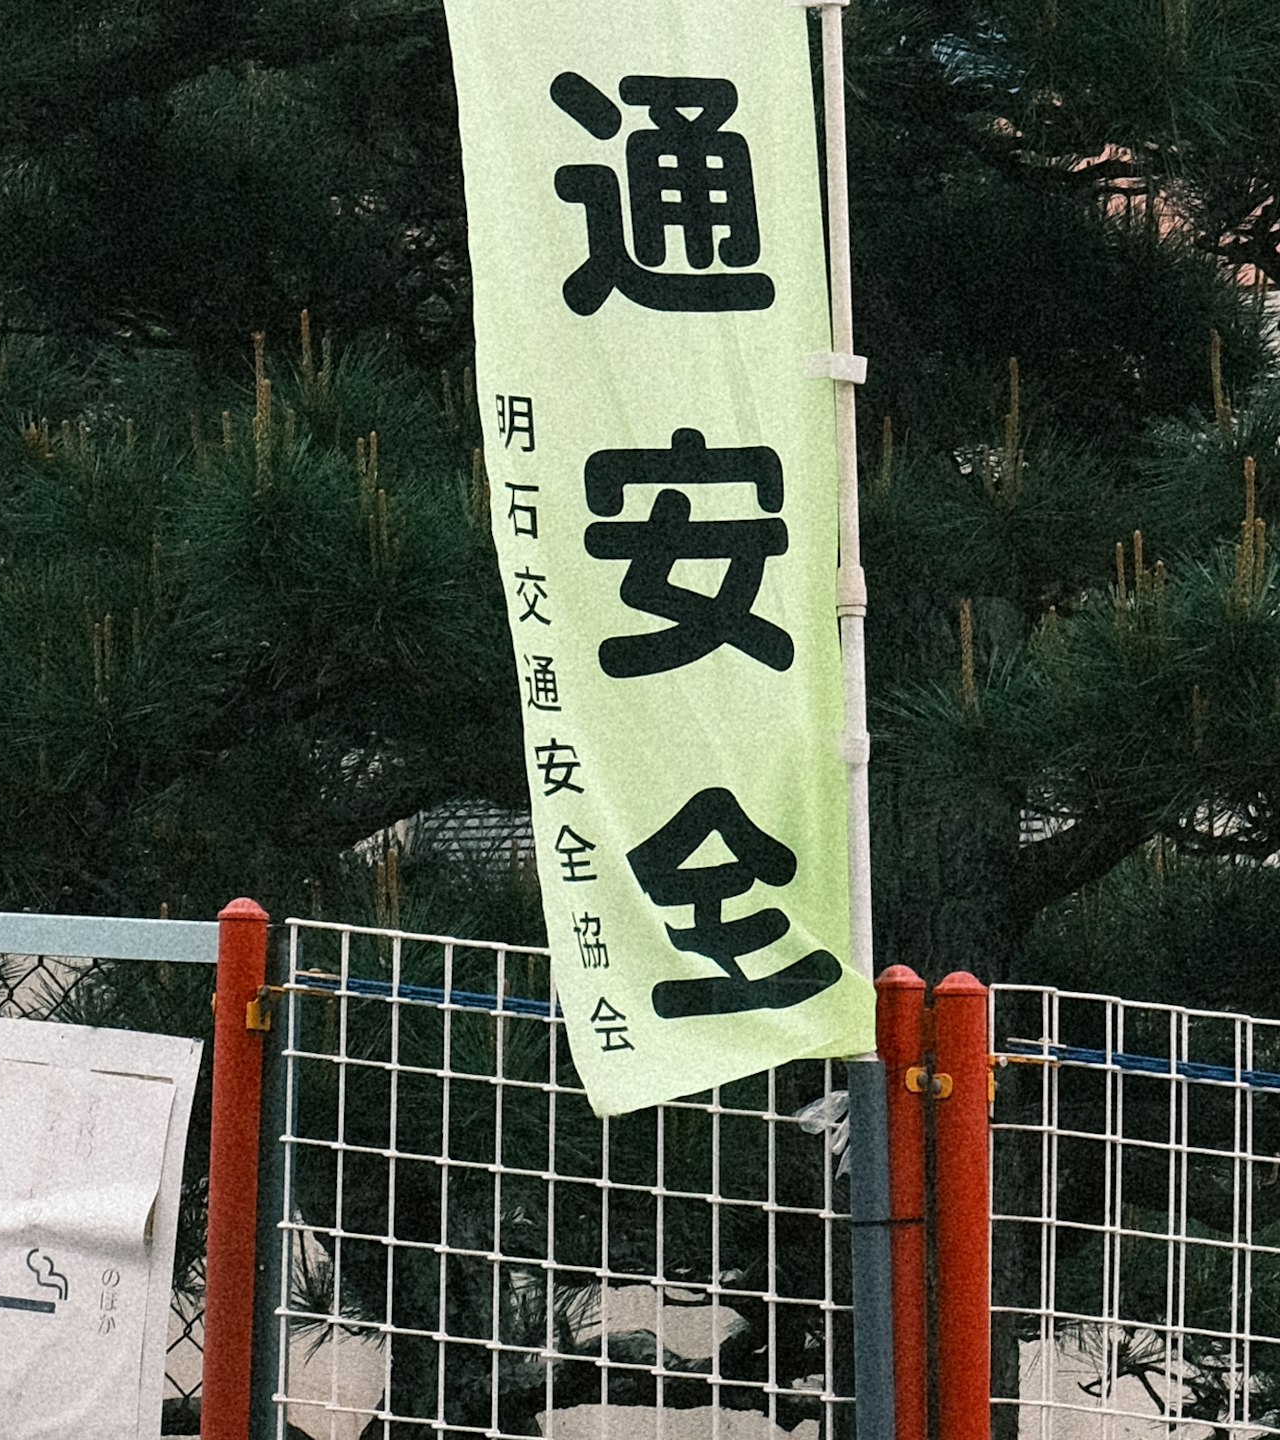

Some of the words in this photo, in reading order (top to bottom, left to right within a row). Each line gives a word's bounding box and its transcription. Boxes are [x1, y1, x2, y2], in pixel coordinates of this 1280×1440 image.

[495, 393, 635, 1053] 明石交通安全協会
